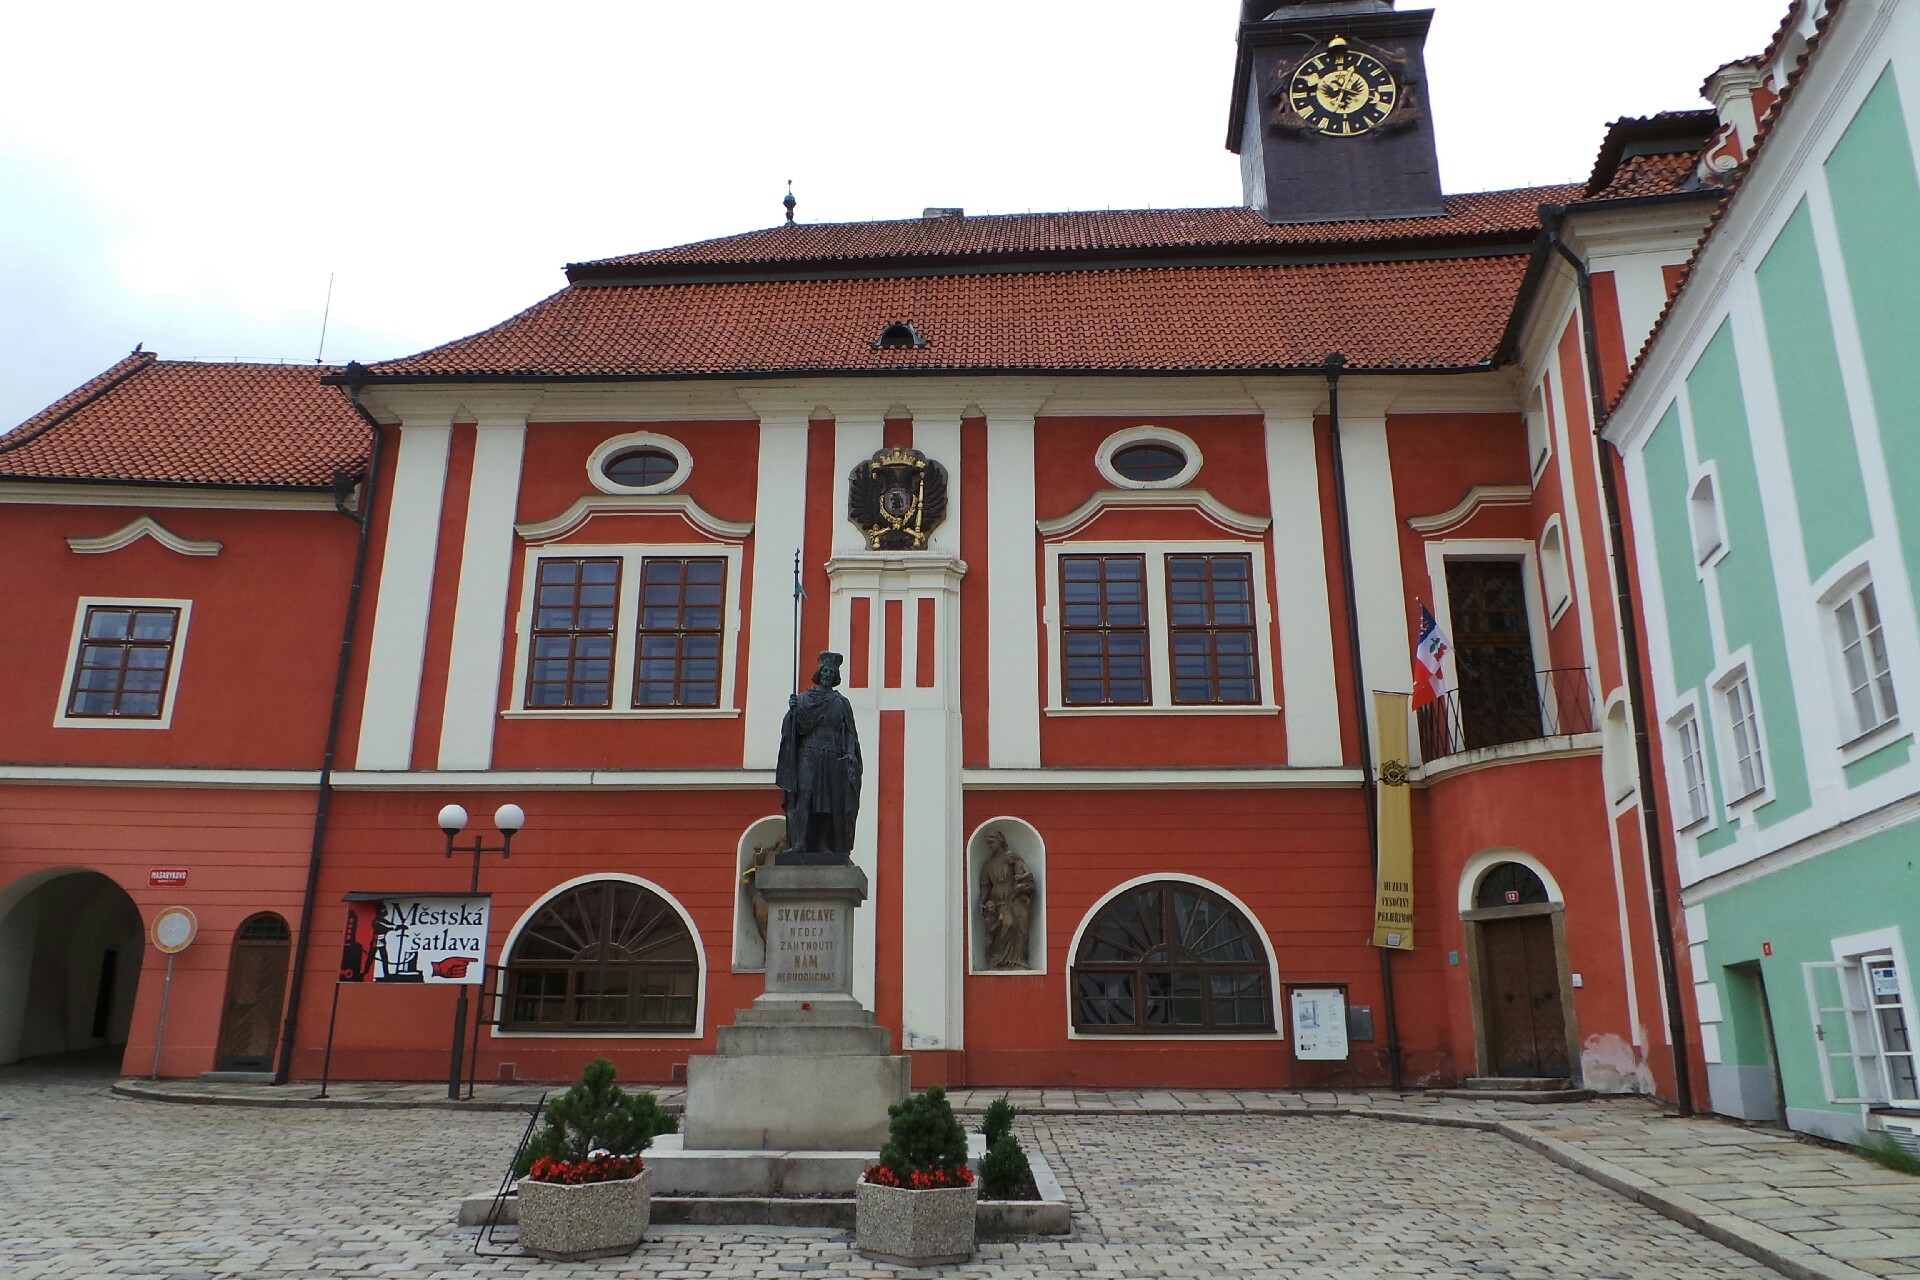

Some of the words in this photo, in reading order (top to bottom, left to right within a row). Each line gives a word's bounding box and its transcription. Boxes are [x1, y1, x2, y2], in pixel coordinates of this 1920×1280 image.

[1383, 881, 1409, 893] MUZEUM
[390, 902, 484, 926] Městská
[790, 927, 823, 937] NEDEJ
[410, 928, 480, 951] šatlava
[780, 941, 833, 951] ZAHYNOUTI
